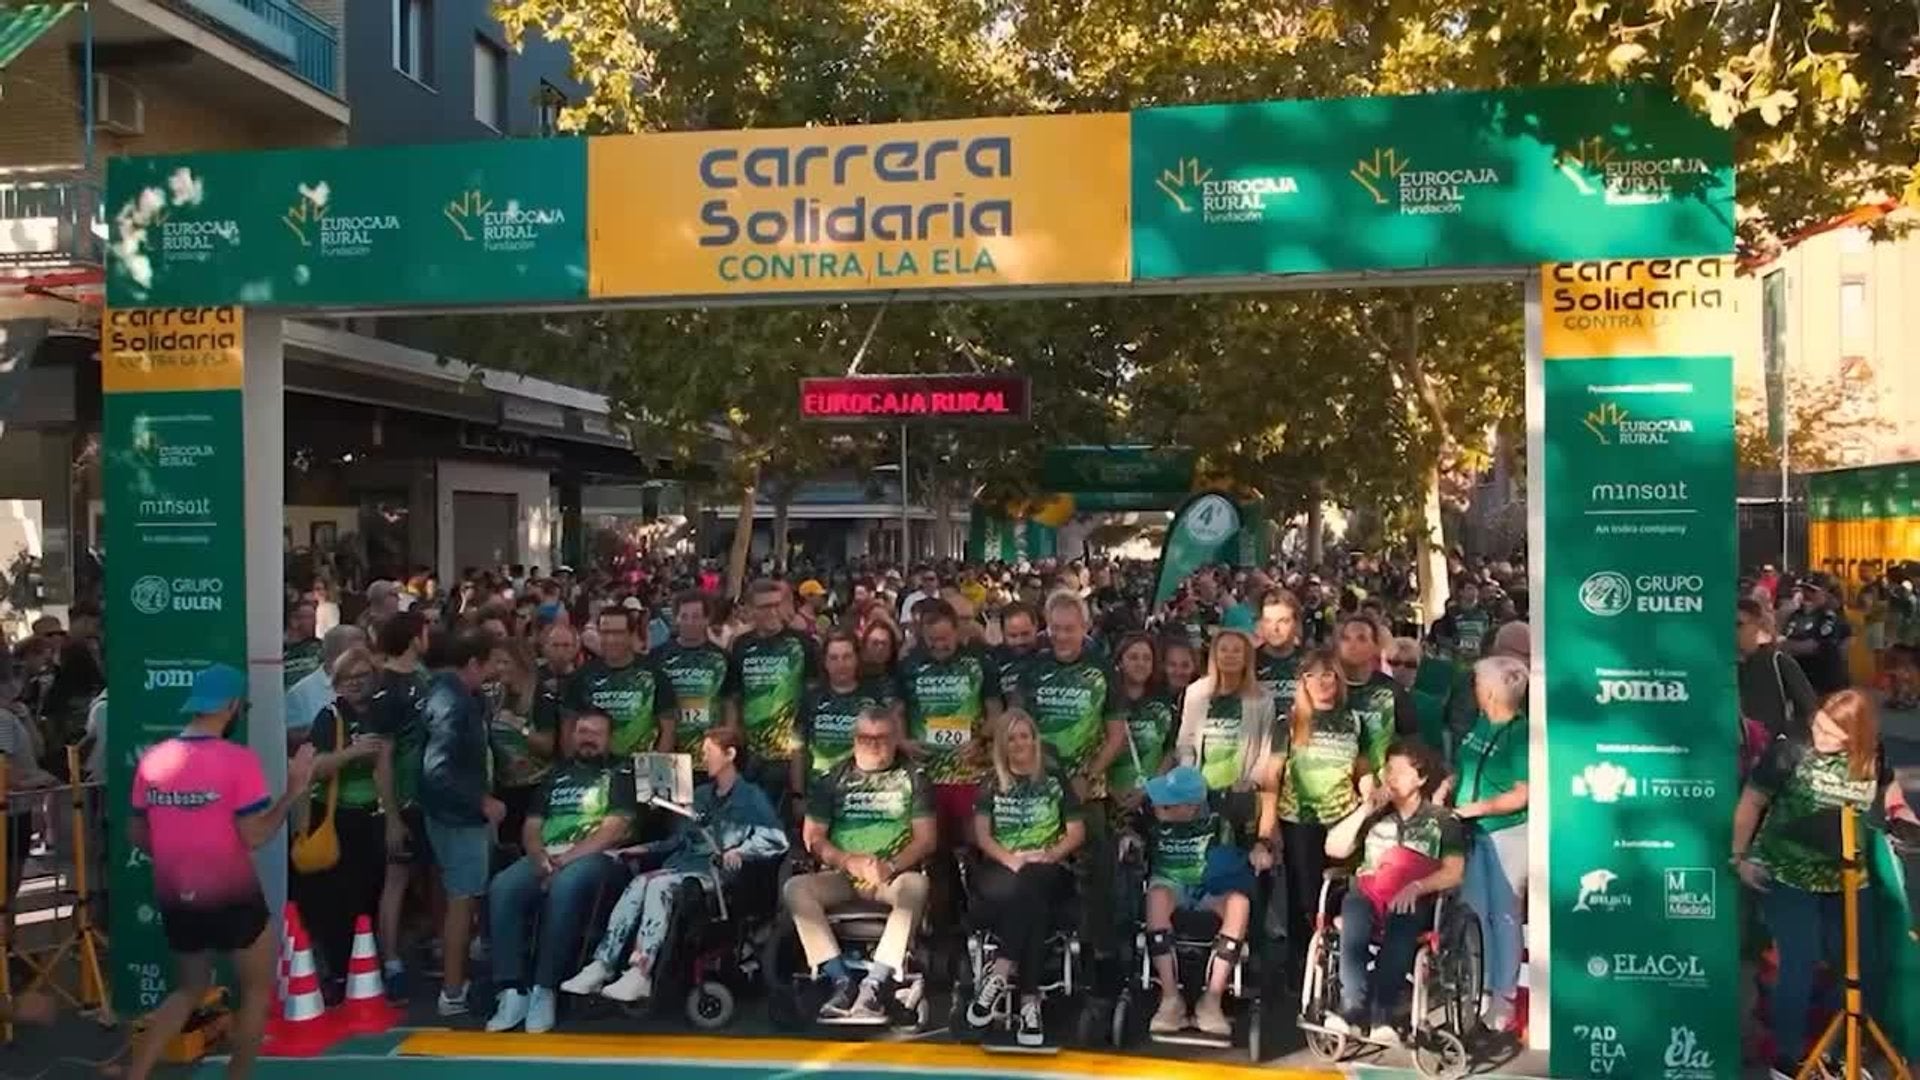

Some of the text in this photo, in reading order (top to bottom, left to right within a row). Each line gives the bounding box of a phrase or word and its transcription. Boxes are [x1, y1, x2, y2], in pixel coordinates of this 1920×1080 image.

[699, 136, 1012, 188] carrera
[1606, 158, 1709, 176] EUROCAJA
[1400, 168, 1499, 187] EUROCAJA
[1606, 176, 1672, 192] RURAL
[1203, 177, 1298, 196] EUROCAJA
[1400, 186, 1465, 203] RURAL
[1203, 194, 1266, 211] RURAL
[320, 216, 400, 231] EUROCAJA
[484, 208, 566, 226] EUROCAJA
[699, 192, 1012, 247] Solidaria
[163, 221, 239, 236] EUROCAJA
[484, 226, 538, 240] RURAL
[163, 236, 214, 250] RURAL
[320, 231, 373, 245] RURAL
[718, 248, 997, 282] CONTRA LA ELA
[1553, 258, 1721, 284] carrera
[1553, 285, 1722, 313] Solidaria
[111, 307, 235, 327] carrera
[1563, 314, 1645, 331] CONTRA
[111, 328, 235, 352] Solidaria
[804, 391, 1009, 415] EUROCAJA RURAL
[1619, 420, 1694, 433] EUROCAJA
[1619, 433, 1669, 445] RURAL
[1592, 481, 1688, 501] minsait
[140, 498, 211, 515] minsait
[172, 578, 223, 593] GRUPO
[1635, 575, 1704, 592] GRUPO
[173, 596, 222, 611] EULEN
[1637, 596, 1702, 613] EULEN
[144, 669, 204, 690] Jom
[934, 730, 963, 744] 620
[1652, 785, 1716, 798] TOLEDO
[1668, 872, 1685, 890] M
[1613, 954, 1705, 979] ELACyL
[1590, 1026, 1617, 1041] AD
[1591, 1043, 1626, 1058] ELA
[1591, 1059, 1615, 1074] CV
